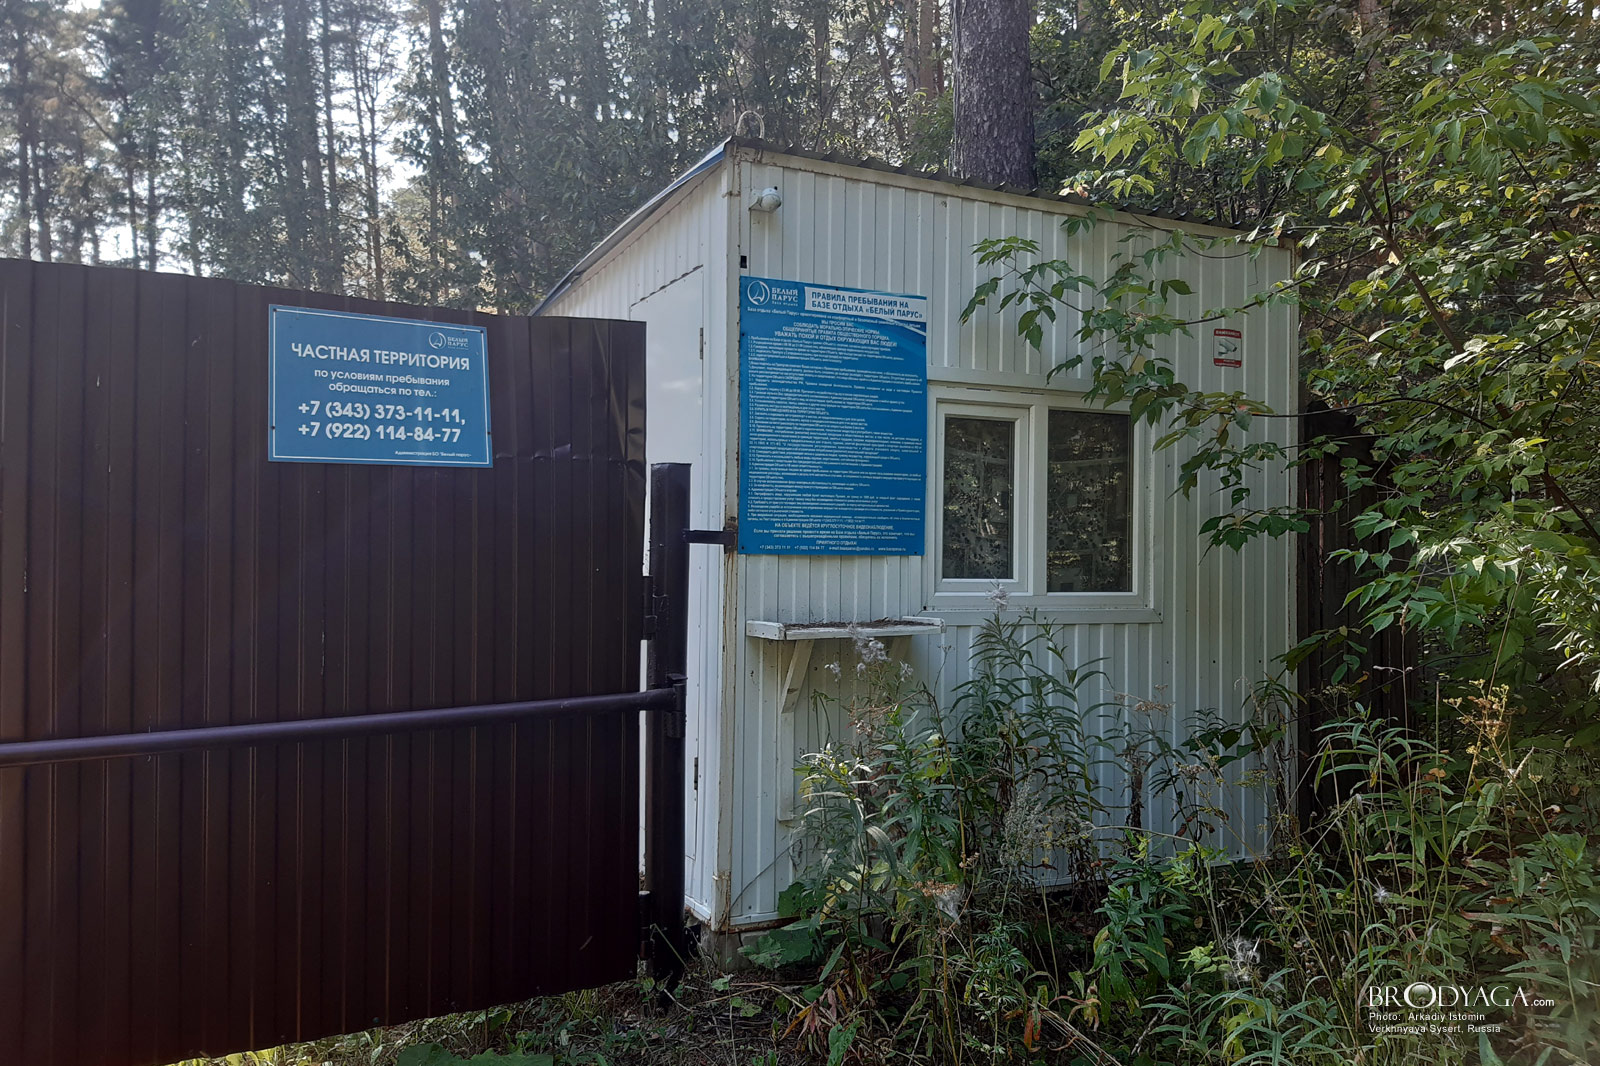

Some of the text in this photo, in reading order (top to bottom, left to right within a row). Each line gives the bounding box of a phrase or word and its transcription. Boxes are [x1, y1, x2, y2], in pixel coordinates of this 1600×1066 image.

[772, 288, 798, 296] БЕЛЫЙ
[772, 294, 798, 302] ПАРУС
[812, 292, 846, 302] ПРАВИЛА
[848, 296, 898, 308] ПРЕБЫВАНИЯ
[812, 300, 922, 318] БАЗЕ ОТДЫХА «БЕЛЫЙ ПАРУС»
[291, 342, 470, 370] ЧАСТНАЯ ТЕРРИТОРИЯ
[314, 370, 450, 386] по условиям пребывания
[329, 382, 396, 394] обращаться
[399, 388, 412, 396] по
[298, 400, 466, 425] +7 (343) 373-11-11,
[298, 422, 461, 442] +7 (922) 114-84-77
